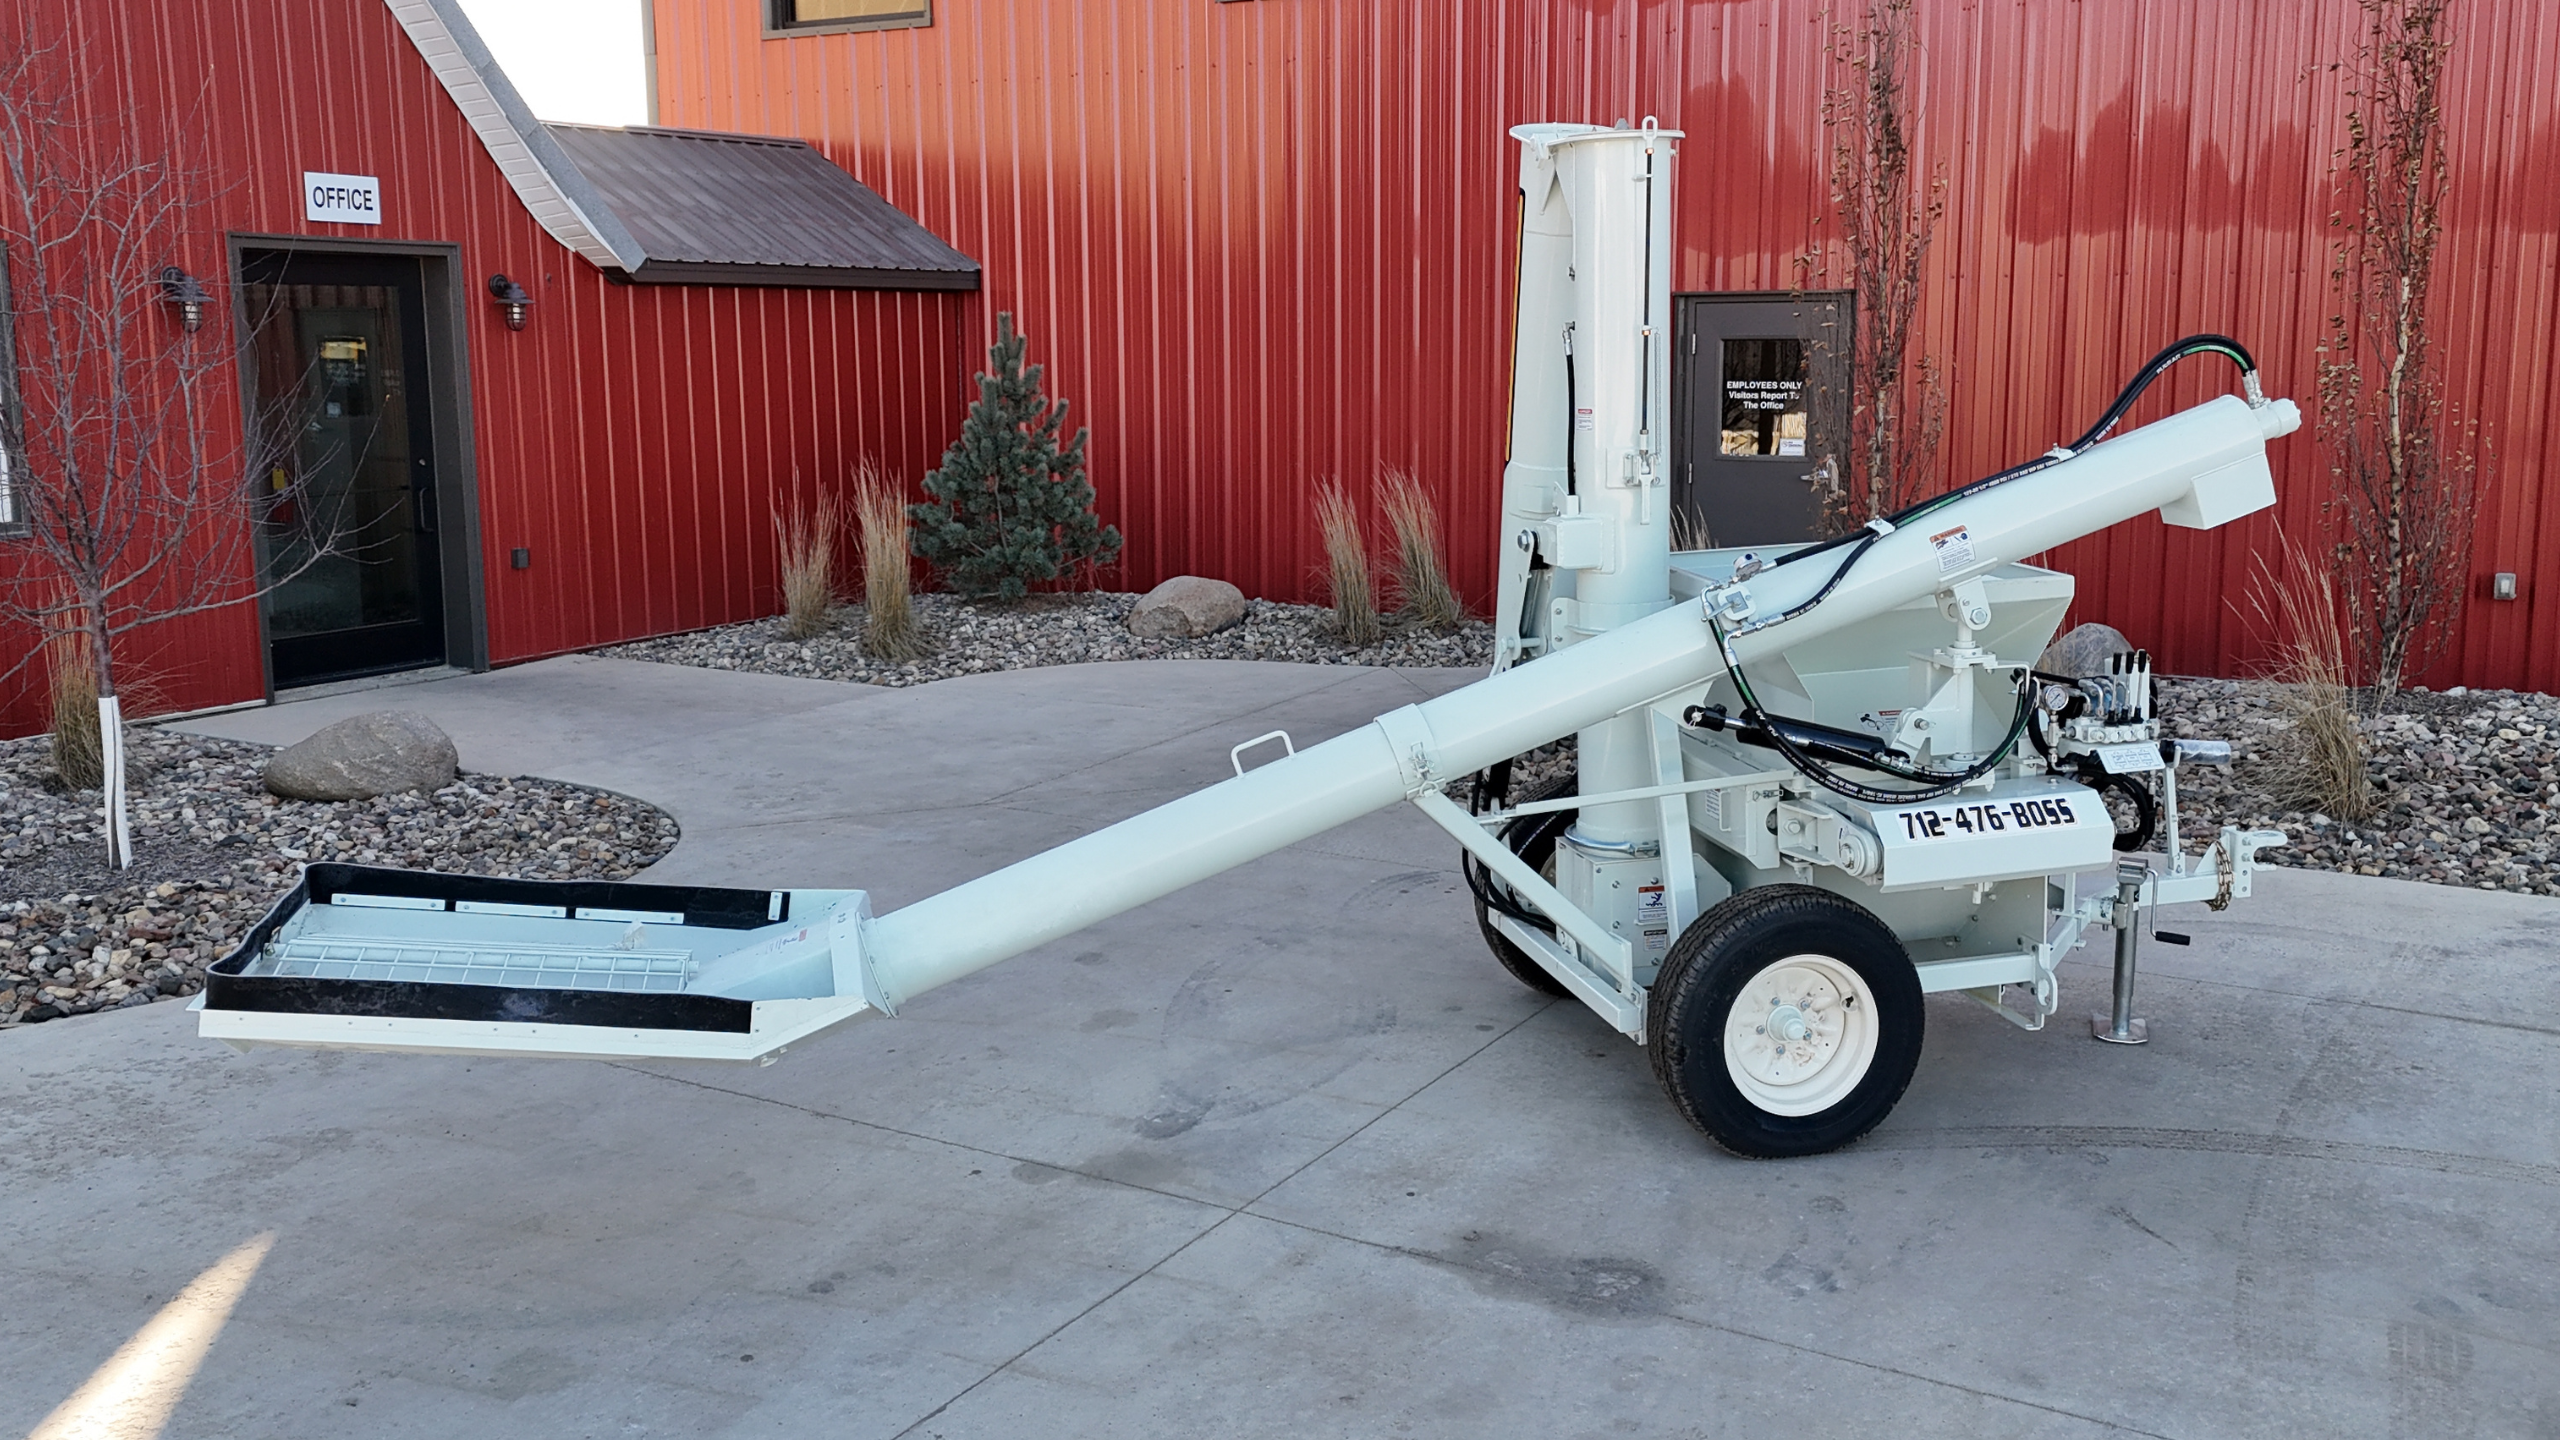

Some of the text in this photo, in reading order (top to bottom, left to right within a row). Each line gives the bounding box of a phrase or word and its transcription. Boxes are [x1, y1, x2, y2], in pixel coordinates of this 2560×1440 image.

[313, 186, 374, 211] OFFICE
[1726, 381, 1803, 389] EMPLOYEES ONLY
[1728, 391, 1759, 399] Visitors
[1760, 391, 1788, 400] Report
[1743, 401, 1785, 409] The Office
[1899, 798, 2076, 840] 712-476-BOSS
